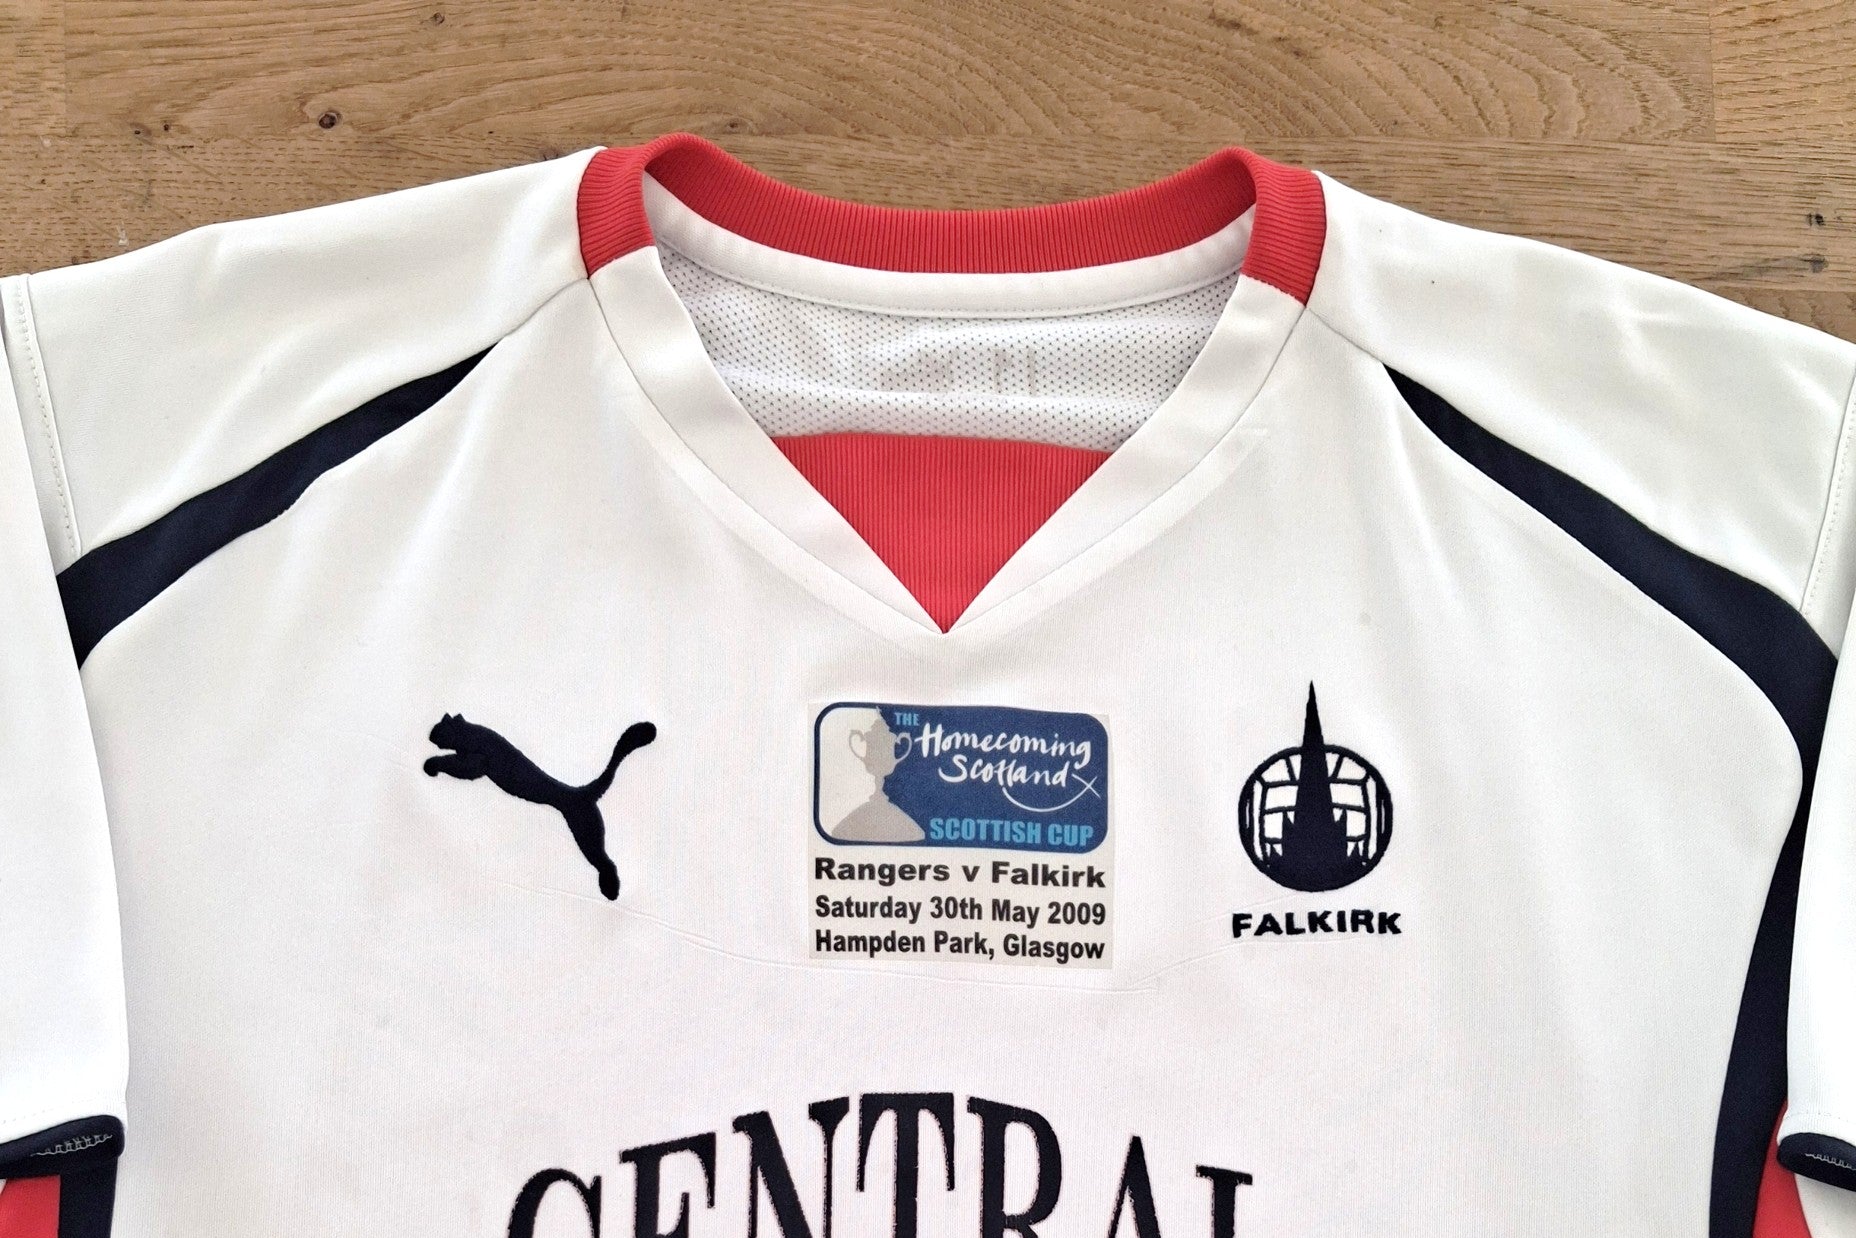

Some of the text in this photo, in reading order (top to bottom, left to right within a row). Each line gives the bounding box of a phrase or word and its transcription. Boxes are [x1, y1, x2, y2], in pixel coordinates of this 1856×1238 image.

[895, 712, 919, 726] THE
[914, 722, 1092, 769] Homecoming
[938, 755, 1071, 787] Scotland
[929, 818, 1094, 846] SCOTTISH CUP
[815, 857, 1106, 888] Rangers v Falkirk
[815, 895, 1106, 929] Saturday 30th May 2009
[1232, 909, 1402, 938] FALKIRK
[815, 929, 1105, 964] Hampden Park, Glasgow
